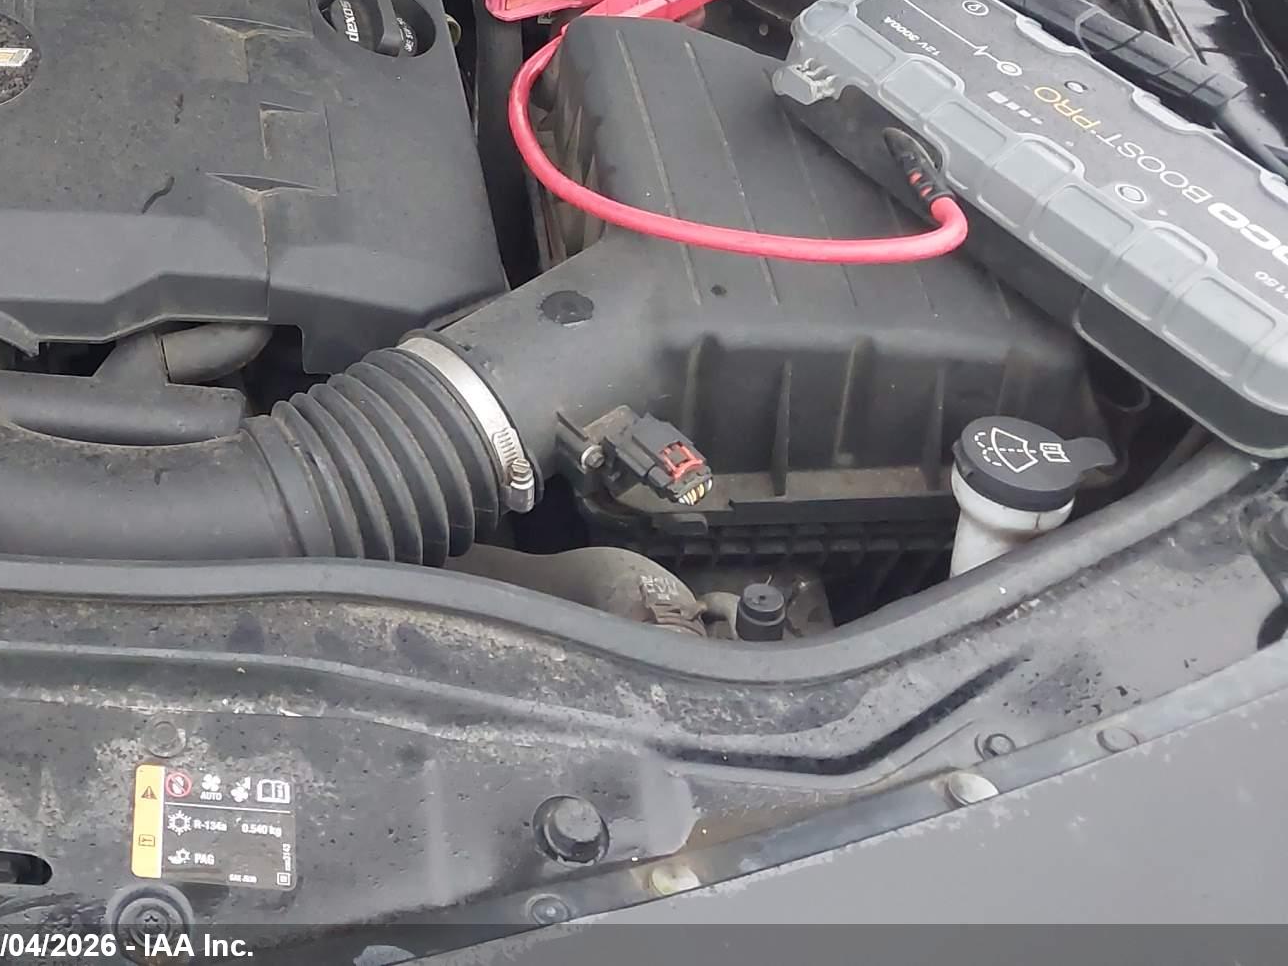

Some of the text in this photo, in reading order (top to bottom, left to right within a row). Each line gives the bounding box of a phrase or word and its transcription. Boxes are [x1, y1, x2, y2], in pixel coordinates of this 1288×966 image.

[341, 0, 360, 43] dexos
[917, 42, 940, 56] 12V
[1034, 86, 1102, 130] PRO
[1096, 133, 1213, 204] BOOST
[1255, 271, 1288, 299] 150
[200, 791, 223, 802] AUTO
[193, 819, 282, 838] R-134a 0.540 kg
[194, 853, 215, 865] PAG
